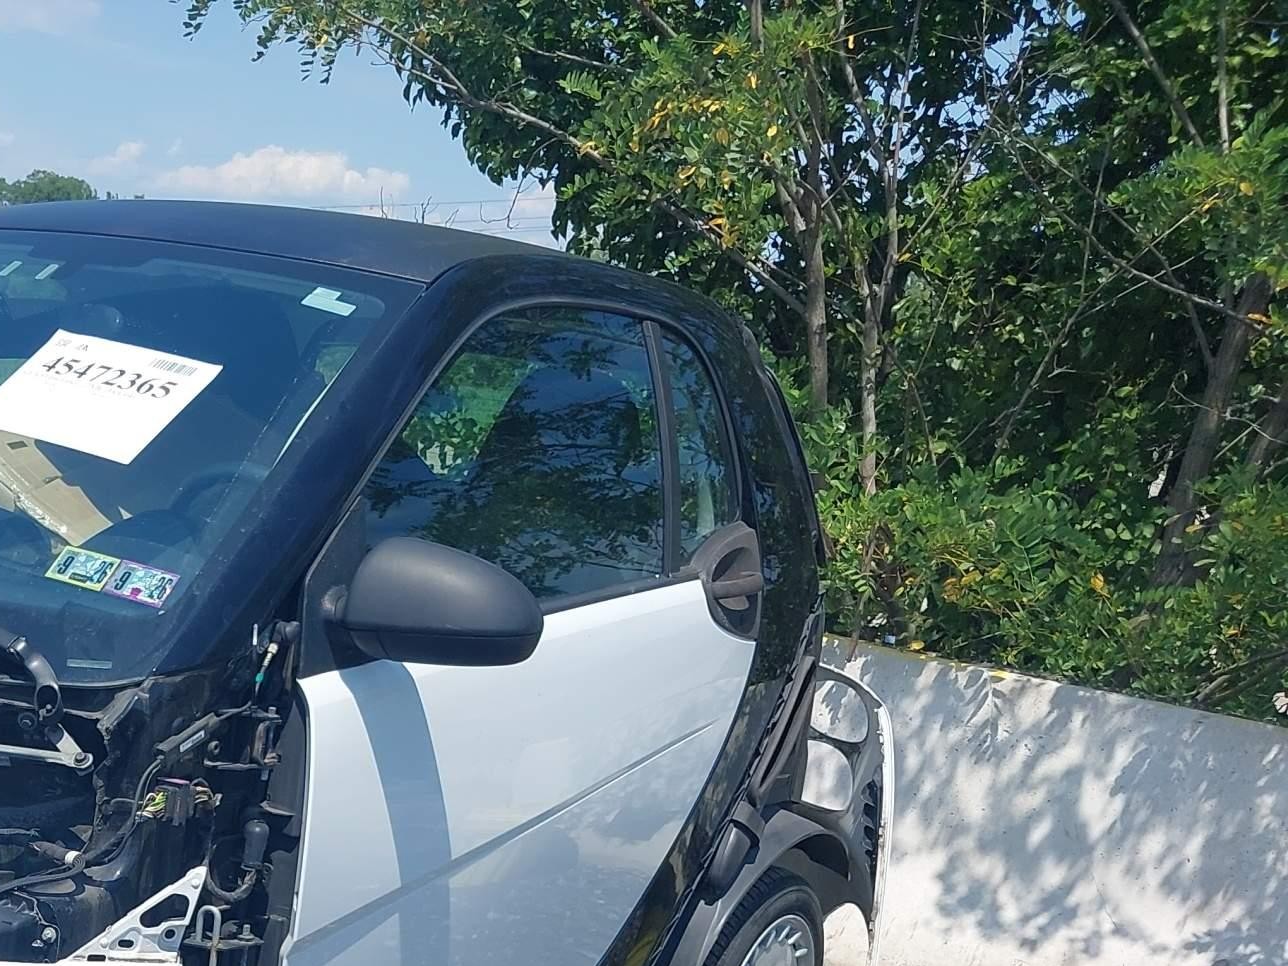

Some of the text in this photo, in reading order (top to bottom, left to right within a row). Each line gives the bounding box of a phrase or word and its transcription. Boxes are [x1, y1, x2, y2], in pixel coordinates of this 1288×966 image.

[42, 356, 177, 399] 45472365
[56, 555, 75, 575] 9
[113, 571, 132, 591] 9
